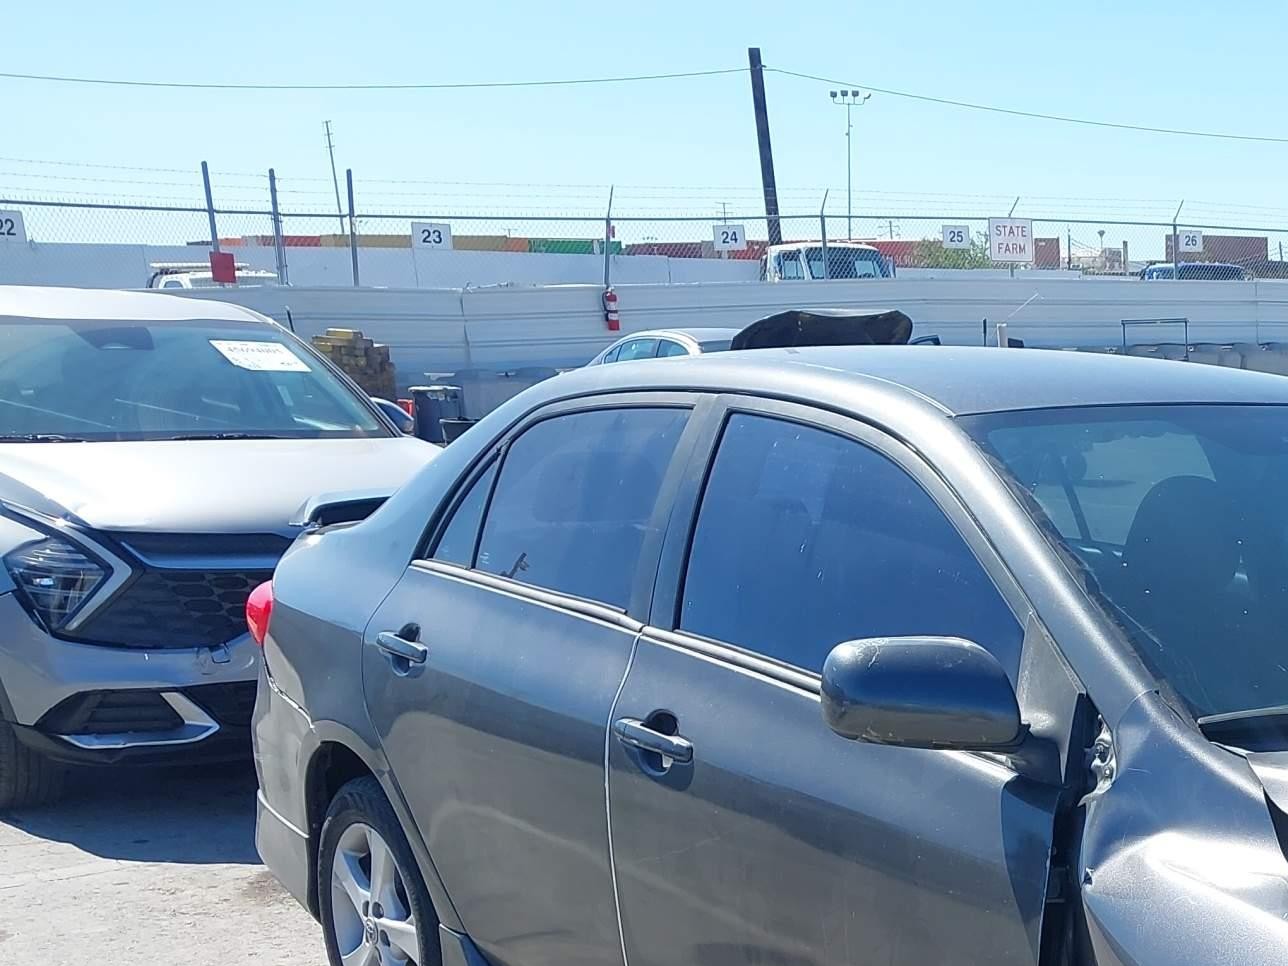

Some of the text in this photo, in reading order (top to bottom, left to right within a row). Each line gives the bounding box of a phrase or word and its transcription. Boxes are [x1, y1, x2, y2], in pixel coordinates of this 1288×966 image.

[421, 228, 443, 245] 23
[721, 230, 738, 244] 24
[948, 230, 964, 243] 25
[995, 225, 1027, 237] STATE
[1184, 235, 1197, 246] 26
[997, 242, 1026, 254] FARM
